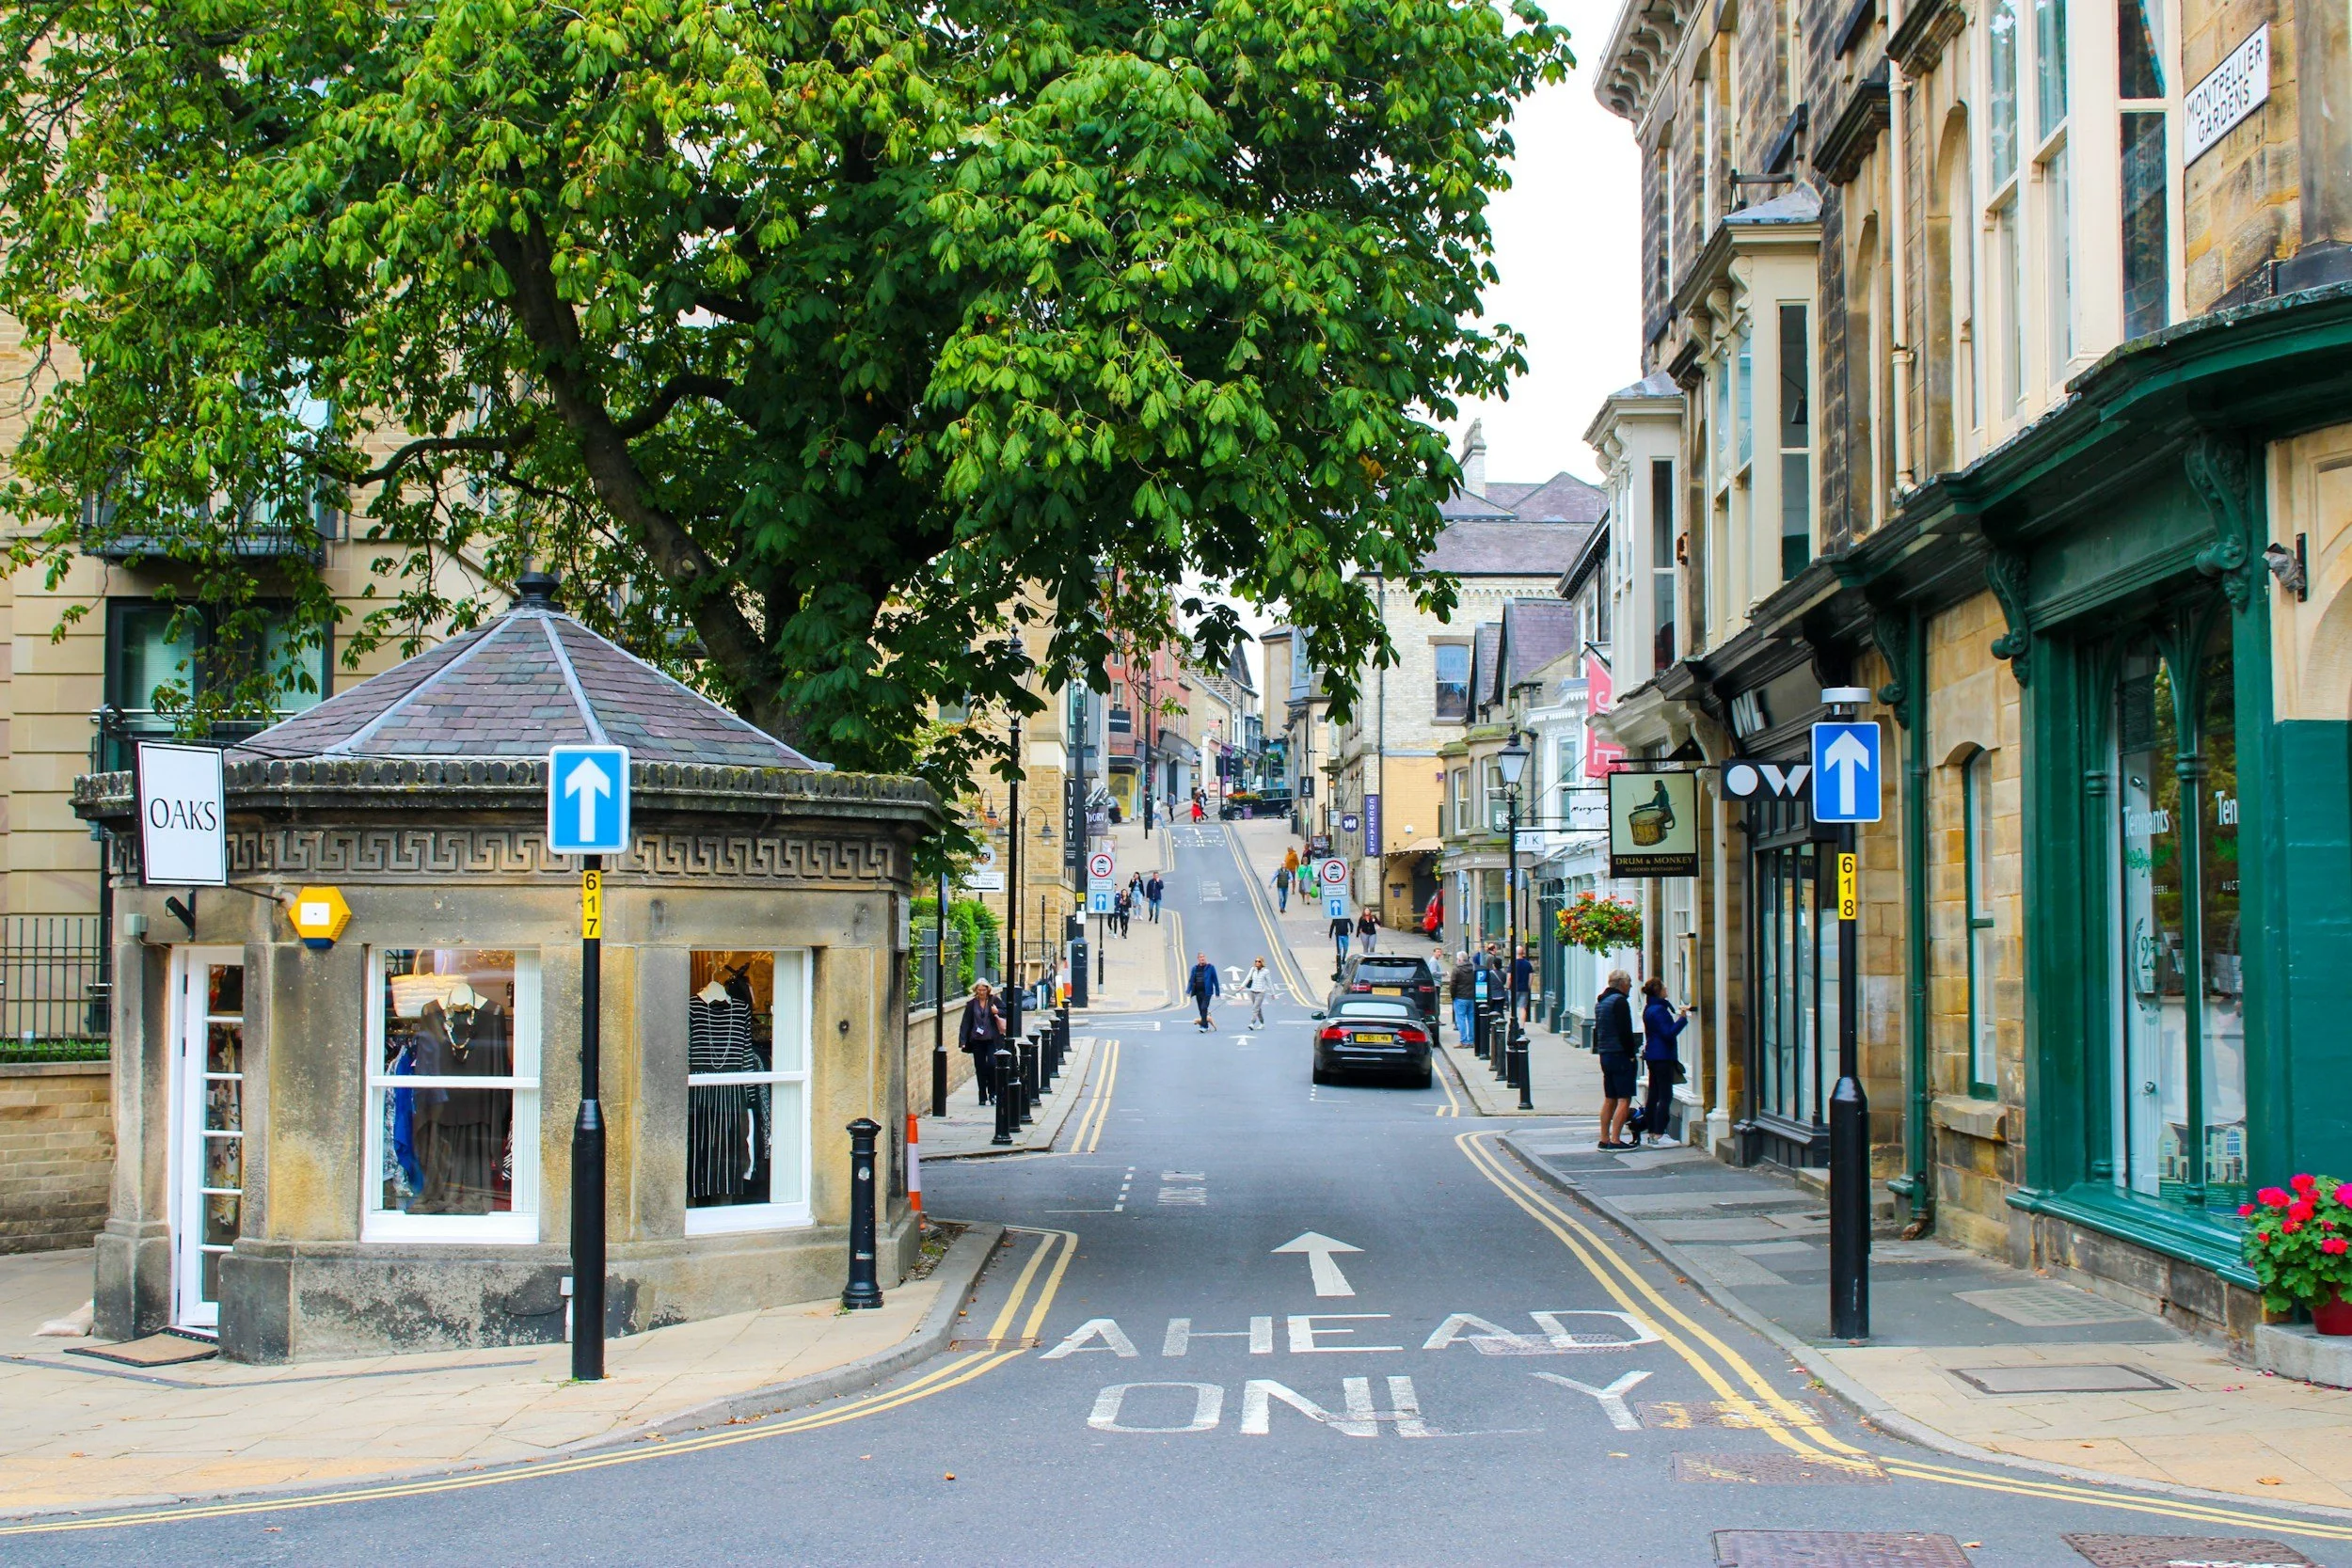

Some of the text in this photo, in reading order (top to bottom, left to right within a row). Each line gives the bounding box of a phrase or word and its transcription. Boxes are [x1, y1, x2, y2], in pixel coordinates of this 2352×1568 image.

[2186, 39, 2263, 126] MONTPELLIER
[2198, 79, 2249, 143] GARDENS
[1594, 690, 1623, 766] SE
[1731, 689, 1766, 739] OWL
[1726, 764, 1812, 798] OW
[150, 798, 216, 832] OAKS
[2122, 805, 2169, 837] Tennants
[1615, 857, 1644, 865] DRUM
[1653, 856, 1693, 864] MONKEY
[1841, 856, 1854, 918] 618
[585, 872, 598, 936] 617
[1040, 1309, 1662, 1359] AHEAD
[1086, 1370, 1654, 1438] ONLY
